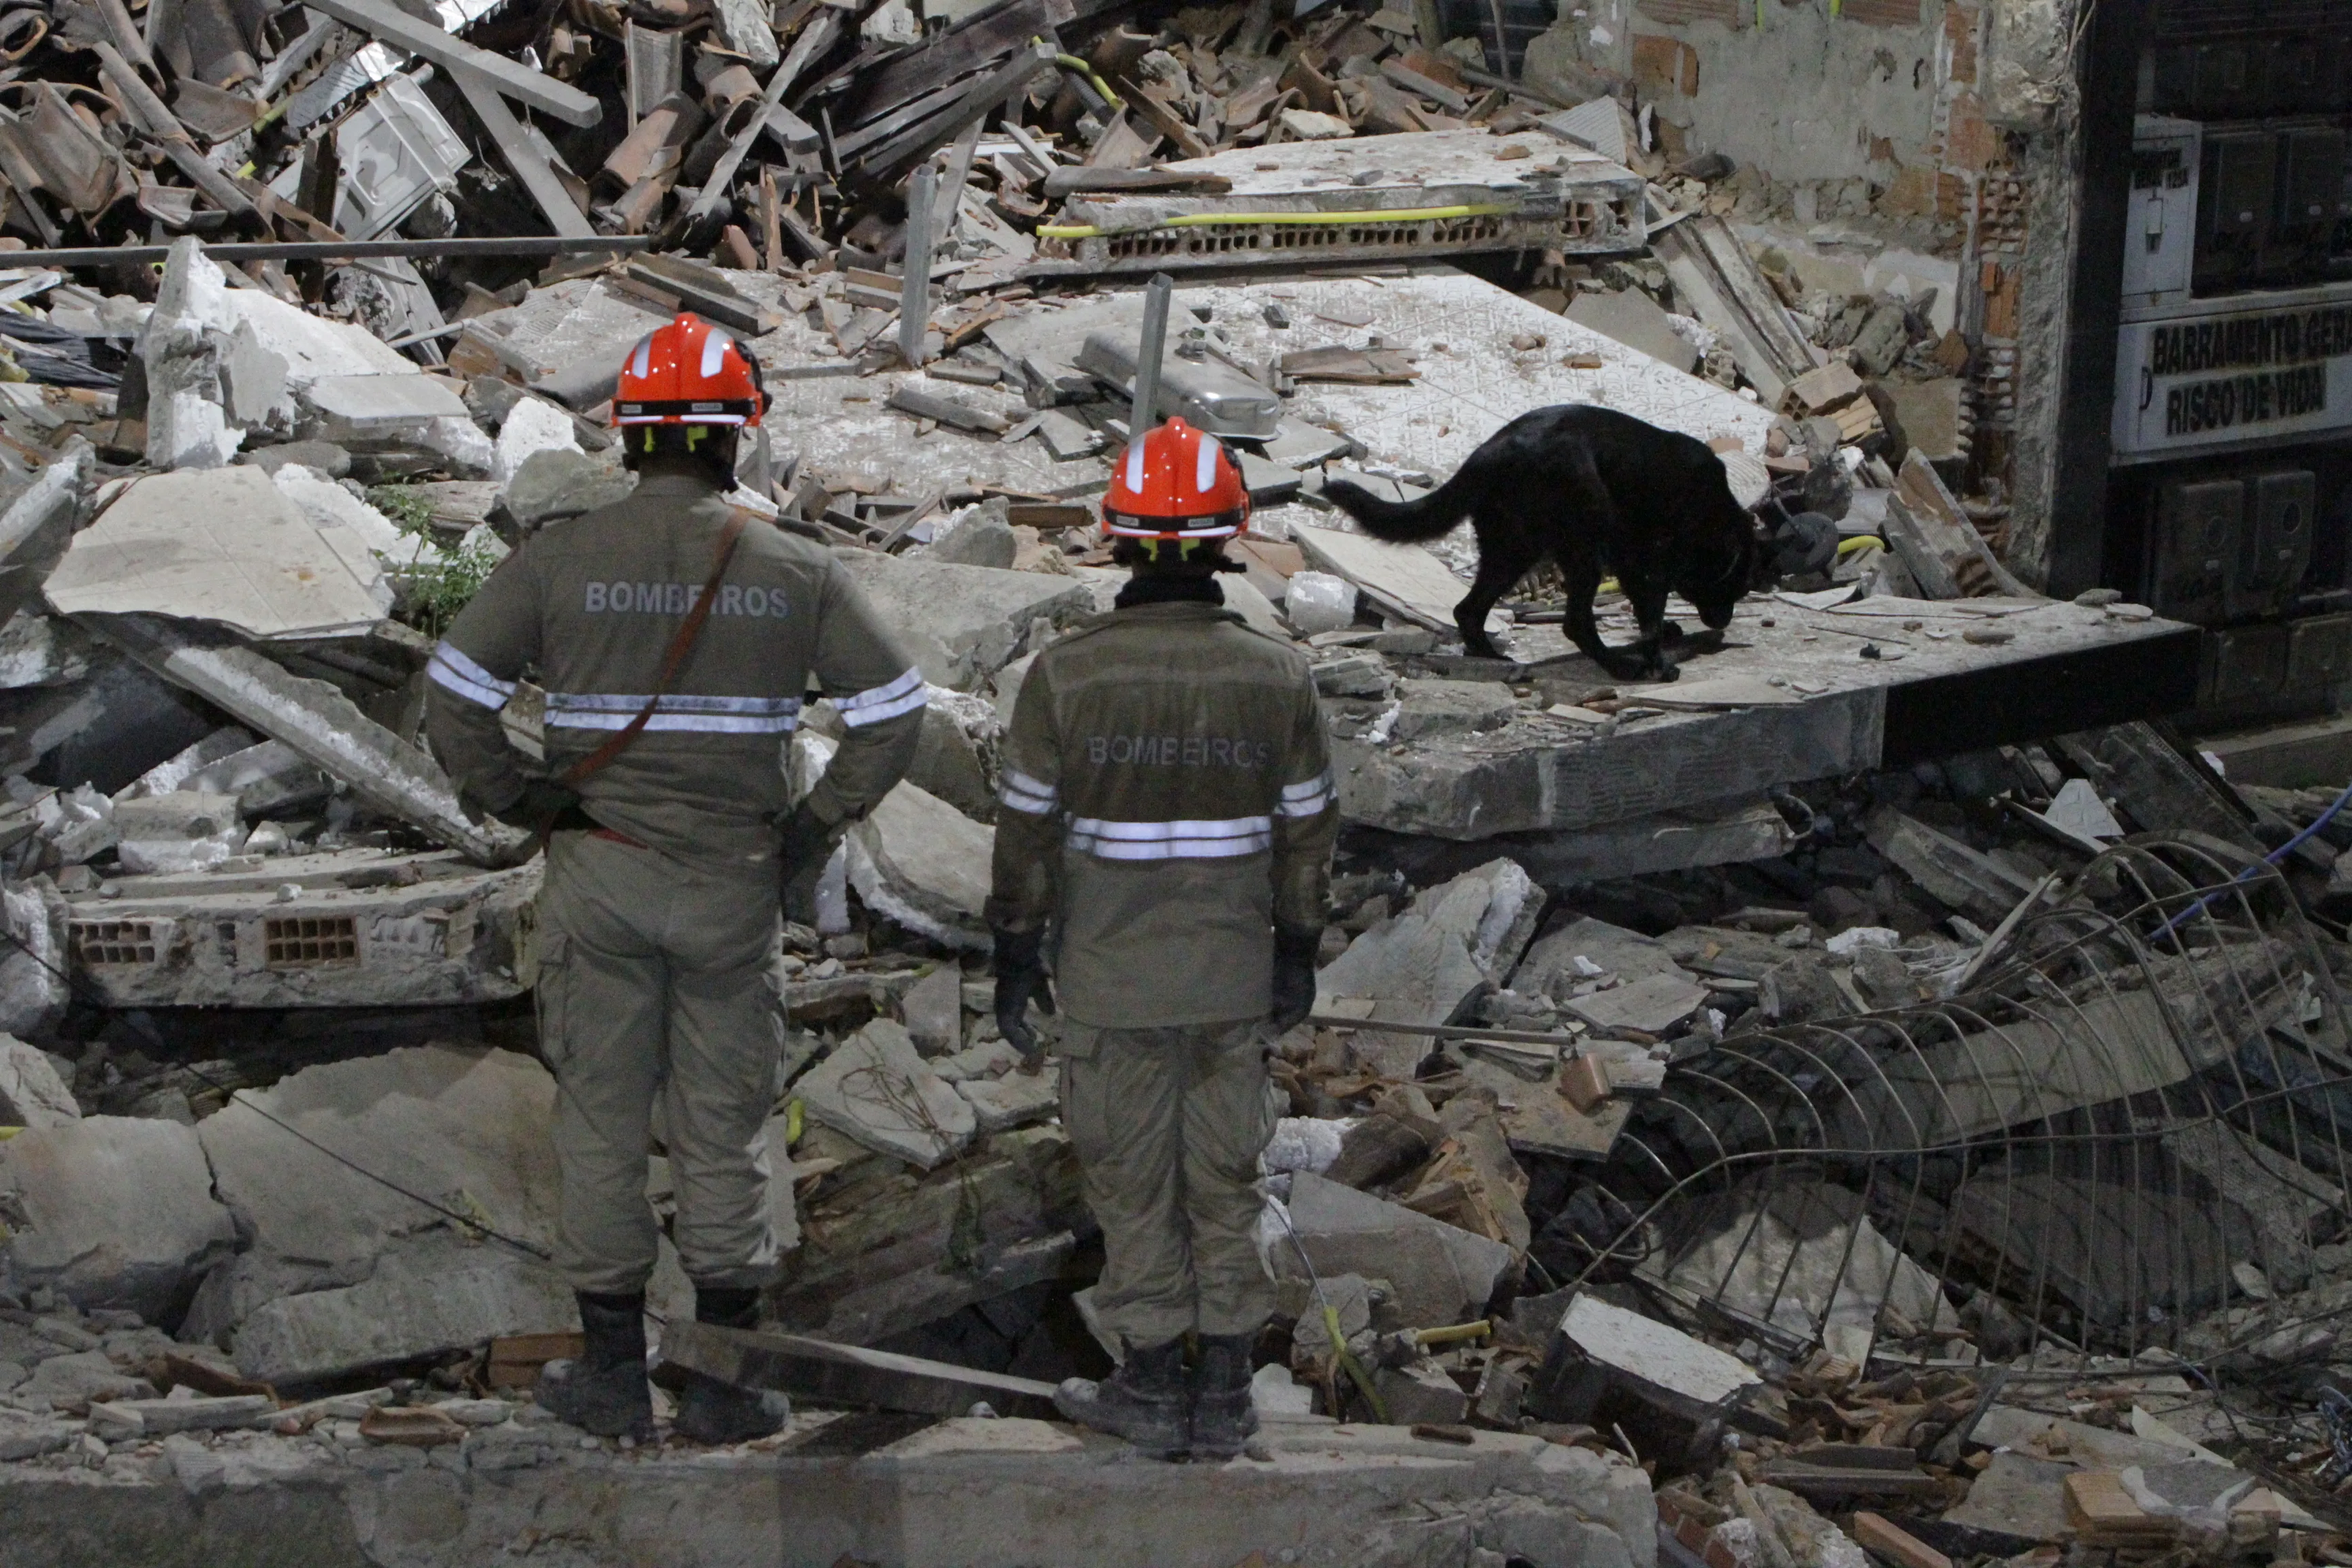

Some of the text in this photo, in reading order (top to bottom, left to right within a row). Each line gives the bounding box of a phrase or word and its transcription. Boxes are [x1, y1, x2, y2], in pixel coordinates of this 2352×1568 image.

[2167, 380, 2235, 436] RISCO
[2242, 374, 2270, 423] DE
[1088, 735, 1271, 767] BOMBEIROS
